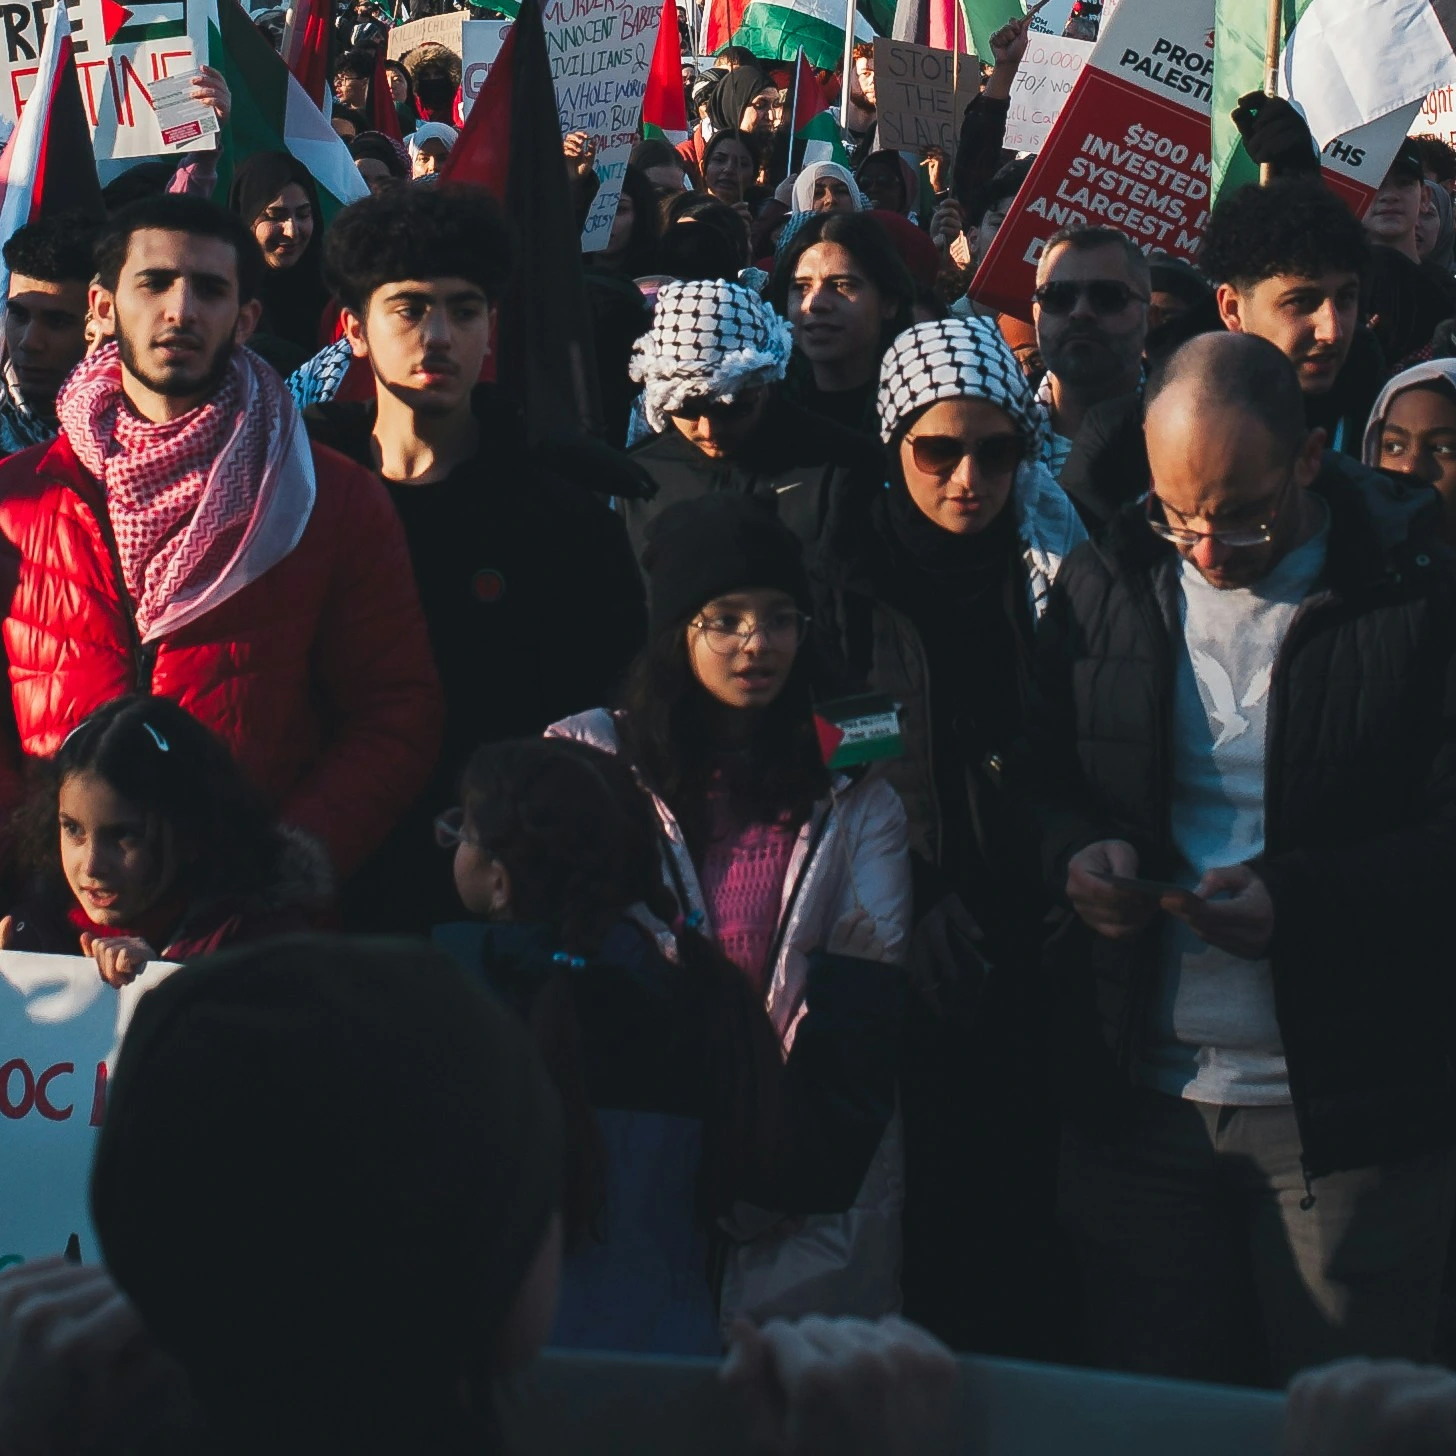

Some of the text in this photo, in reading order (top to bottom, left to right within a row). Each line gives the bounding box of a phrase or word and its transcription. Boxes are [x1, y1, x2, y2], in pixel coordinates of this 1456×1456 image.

[888, 47, 962, 81] STOP
[555, 80, 615, 112] WHOLE
[895, 82, 953, 115] THE
[1016, 70, 1047, 96] 70%
[611, 104, 639, 132] BUT
[1122, 122, 1190, 166] $500
[1080, 132, 1209, 202] INVESTED
[1067, 155, 1190, 226] SYSTEMS,
[1054, 178, 1176, 241] LARGEST
